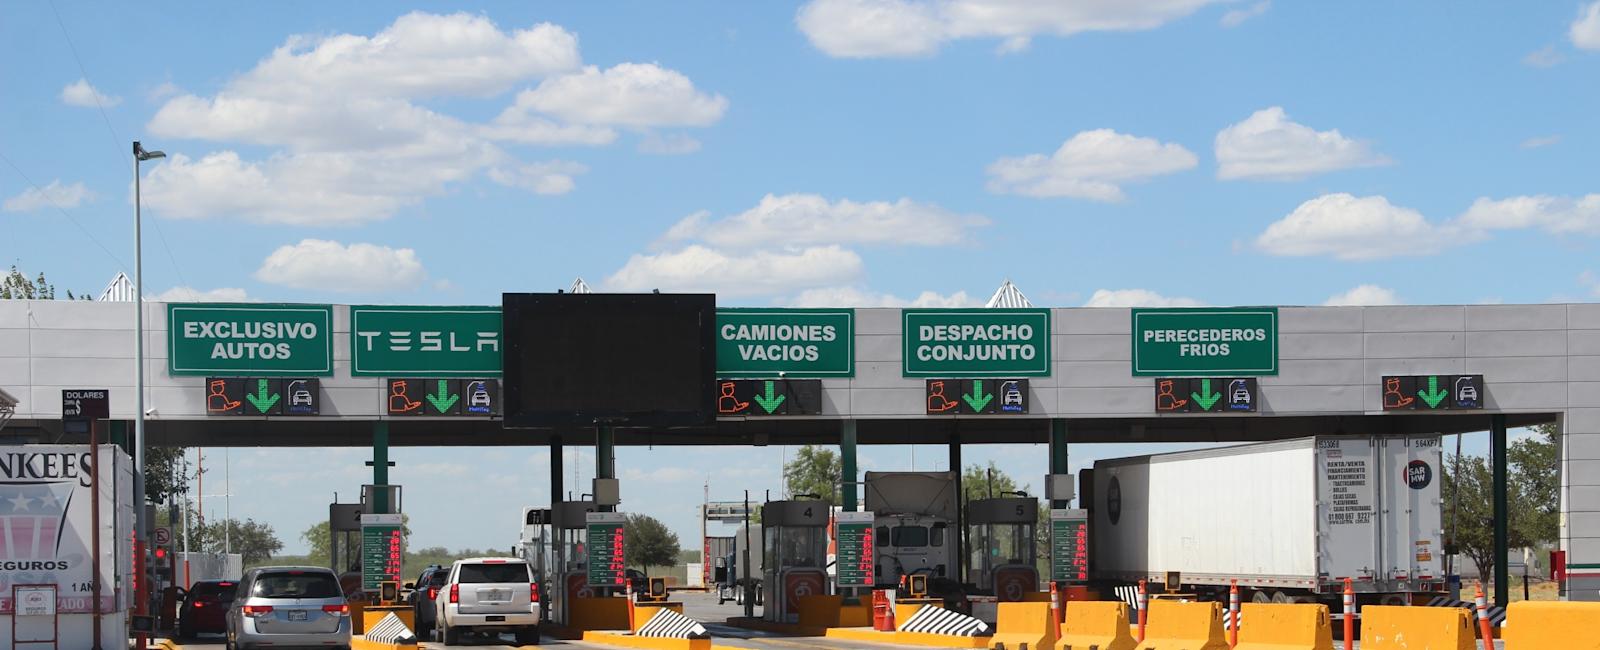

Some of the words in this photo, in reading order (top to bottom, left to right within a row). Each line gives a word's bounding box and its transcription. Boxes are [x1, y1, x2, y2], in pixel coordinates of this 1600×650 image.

[184, 321, 317, 339] EXCLUSIVO
[721, 324, 836, 341] CAMIONES
[919, 324, 1033, 341] DESPACHO
[1144, 328, 1266, 342] PERECEDEROS
[358, 331, 498, 351] TESLA
[211, 342, 291, 359] AUTOS
[738, 344, 819, 361] VACIOS
[917, 344, 1036, 361] CONJUNTO
[1180, 344, 1230, 356] FRIOS
[66, 391, 104, 399] DOLARES
[1409, 467, 1425, 475] SAR
[1411, 474, 1425, 483] MW
[804, 507, 813, 519] 4
[1015, 504, 1024, 516] 5
[72, 583, 76, 592] 1
[80, 581, 101, 592] AÑ
